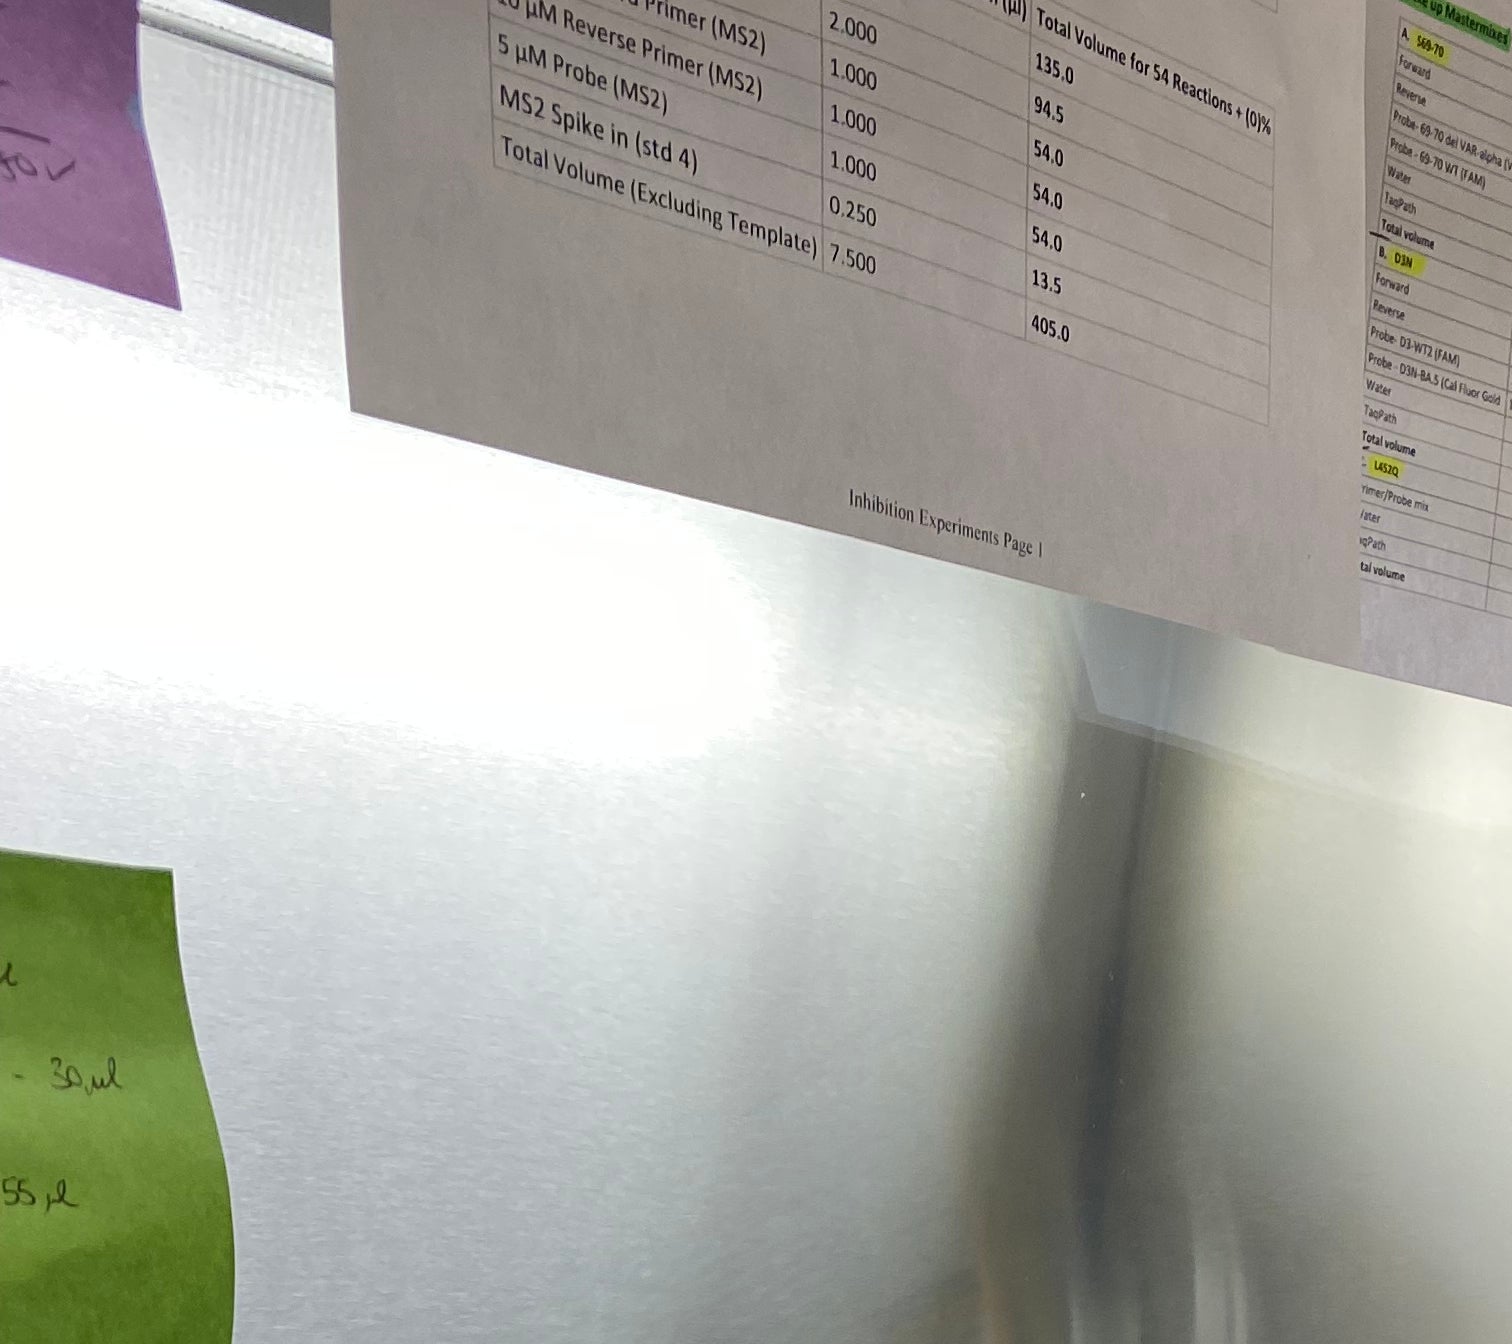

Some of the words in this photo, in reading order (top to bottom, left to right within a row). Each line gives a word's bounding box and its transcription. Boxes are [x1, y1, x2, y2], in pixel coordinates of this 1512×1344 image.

[712, 15, 766, 56] (MS2)
[829, 11, 877, 45] 2.000
[1401, 27, 1410, 41] A.
[1430, 1, 1444, 17] up
[1445, 1, 1509, 45] Mastermixes
[564, 9, 636, 54] Reverse
[642, 37, 704, 77] Primer
[709, 61, 763, 102] (MS2)
[1035, 52, 1075, 86] 135.0
[1037, 7, 1071, 40] Total
[1074, 25, 1127, 66] Volume
[1130, 51, 1150, 77] for
[1153, 63, 1170, 86] 54
[1172, 72, 1233, 116] Reactions
[1399, 54, 1431, 80] Forward
[498, 33, 509, 55] 5
[516, 44, 547, 69] µM
[554, 53, 608, 91] Probe
[613, 74, 668, 117] (MS2)
[830, 58, 877, 91] 1.000
[1396, 82, 1427, 107] Reverse
[830, 104, 877, 137] 1.000
[1034, 96, 1064, 124] 94.5
[500, 84, 545, 119] MS2
[551, 102, 604, 140] Spike
[611, 123, 628, 149] in
[635, 130, 672, 164] (std
[679, 147, 698, 176] 4)
[831, 150, 877, 182] 1.000
[1034, 139, 1064, 167] 54.0
[1387, 165, 1412, 185] Water
[502, 135, 549, 170] Total
[554, 155, 625, 195] Volume
[631, 179, 723, 231] (Excluding
[729, 211, 817, 260] Template)
[1033, 183, 1063, 210] 54.0
[1385, 191, 1417, 215] TaqPath
[829, 195, 877, 228] 0.250
[1032, 225, 1062, 253] 54.0
[1381, 218, 1402, 237] Total
[1404, 230, 1435, 250] volume
[830, 243, 877, 275] 7.500
[1379, 246, 1387, 260] B.
[1394, 252, 1413, 269] D3N
[1032, 269, 1062, 295] 13.5
[1375, 272, 1410, 296] Forward
[1373, 299, 1405, 321] Reverse
[1031, 314, 1070, 343] 405.0
[1368, 352, 1392, 371] Probe
[1366, 379, 1392, 397] Water
[1364, 404, 1397, 425] TaqPath
[1362, 430, 1384, 447] Total
[1384, 437, 1417, 457] volume
[1414, 500, 1430, 512] mix
[849, 488, 914, 523] Inhibition
[919, 508, 999, 546] Experiments
[1004, 532, 1033, 558] Page
[1373, 566, 1405, 583] volume
